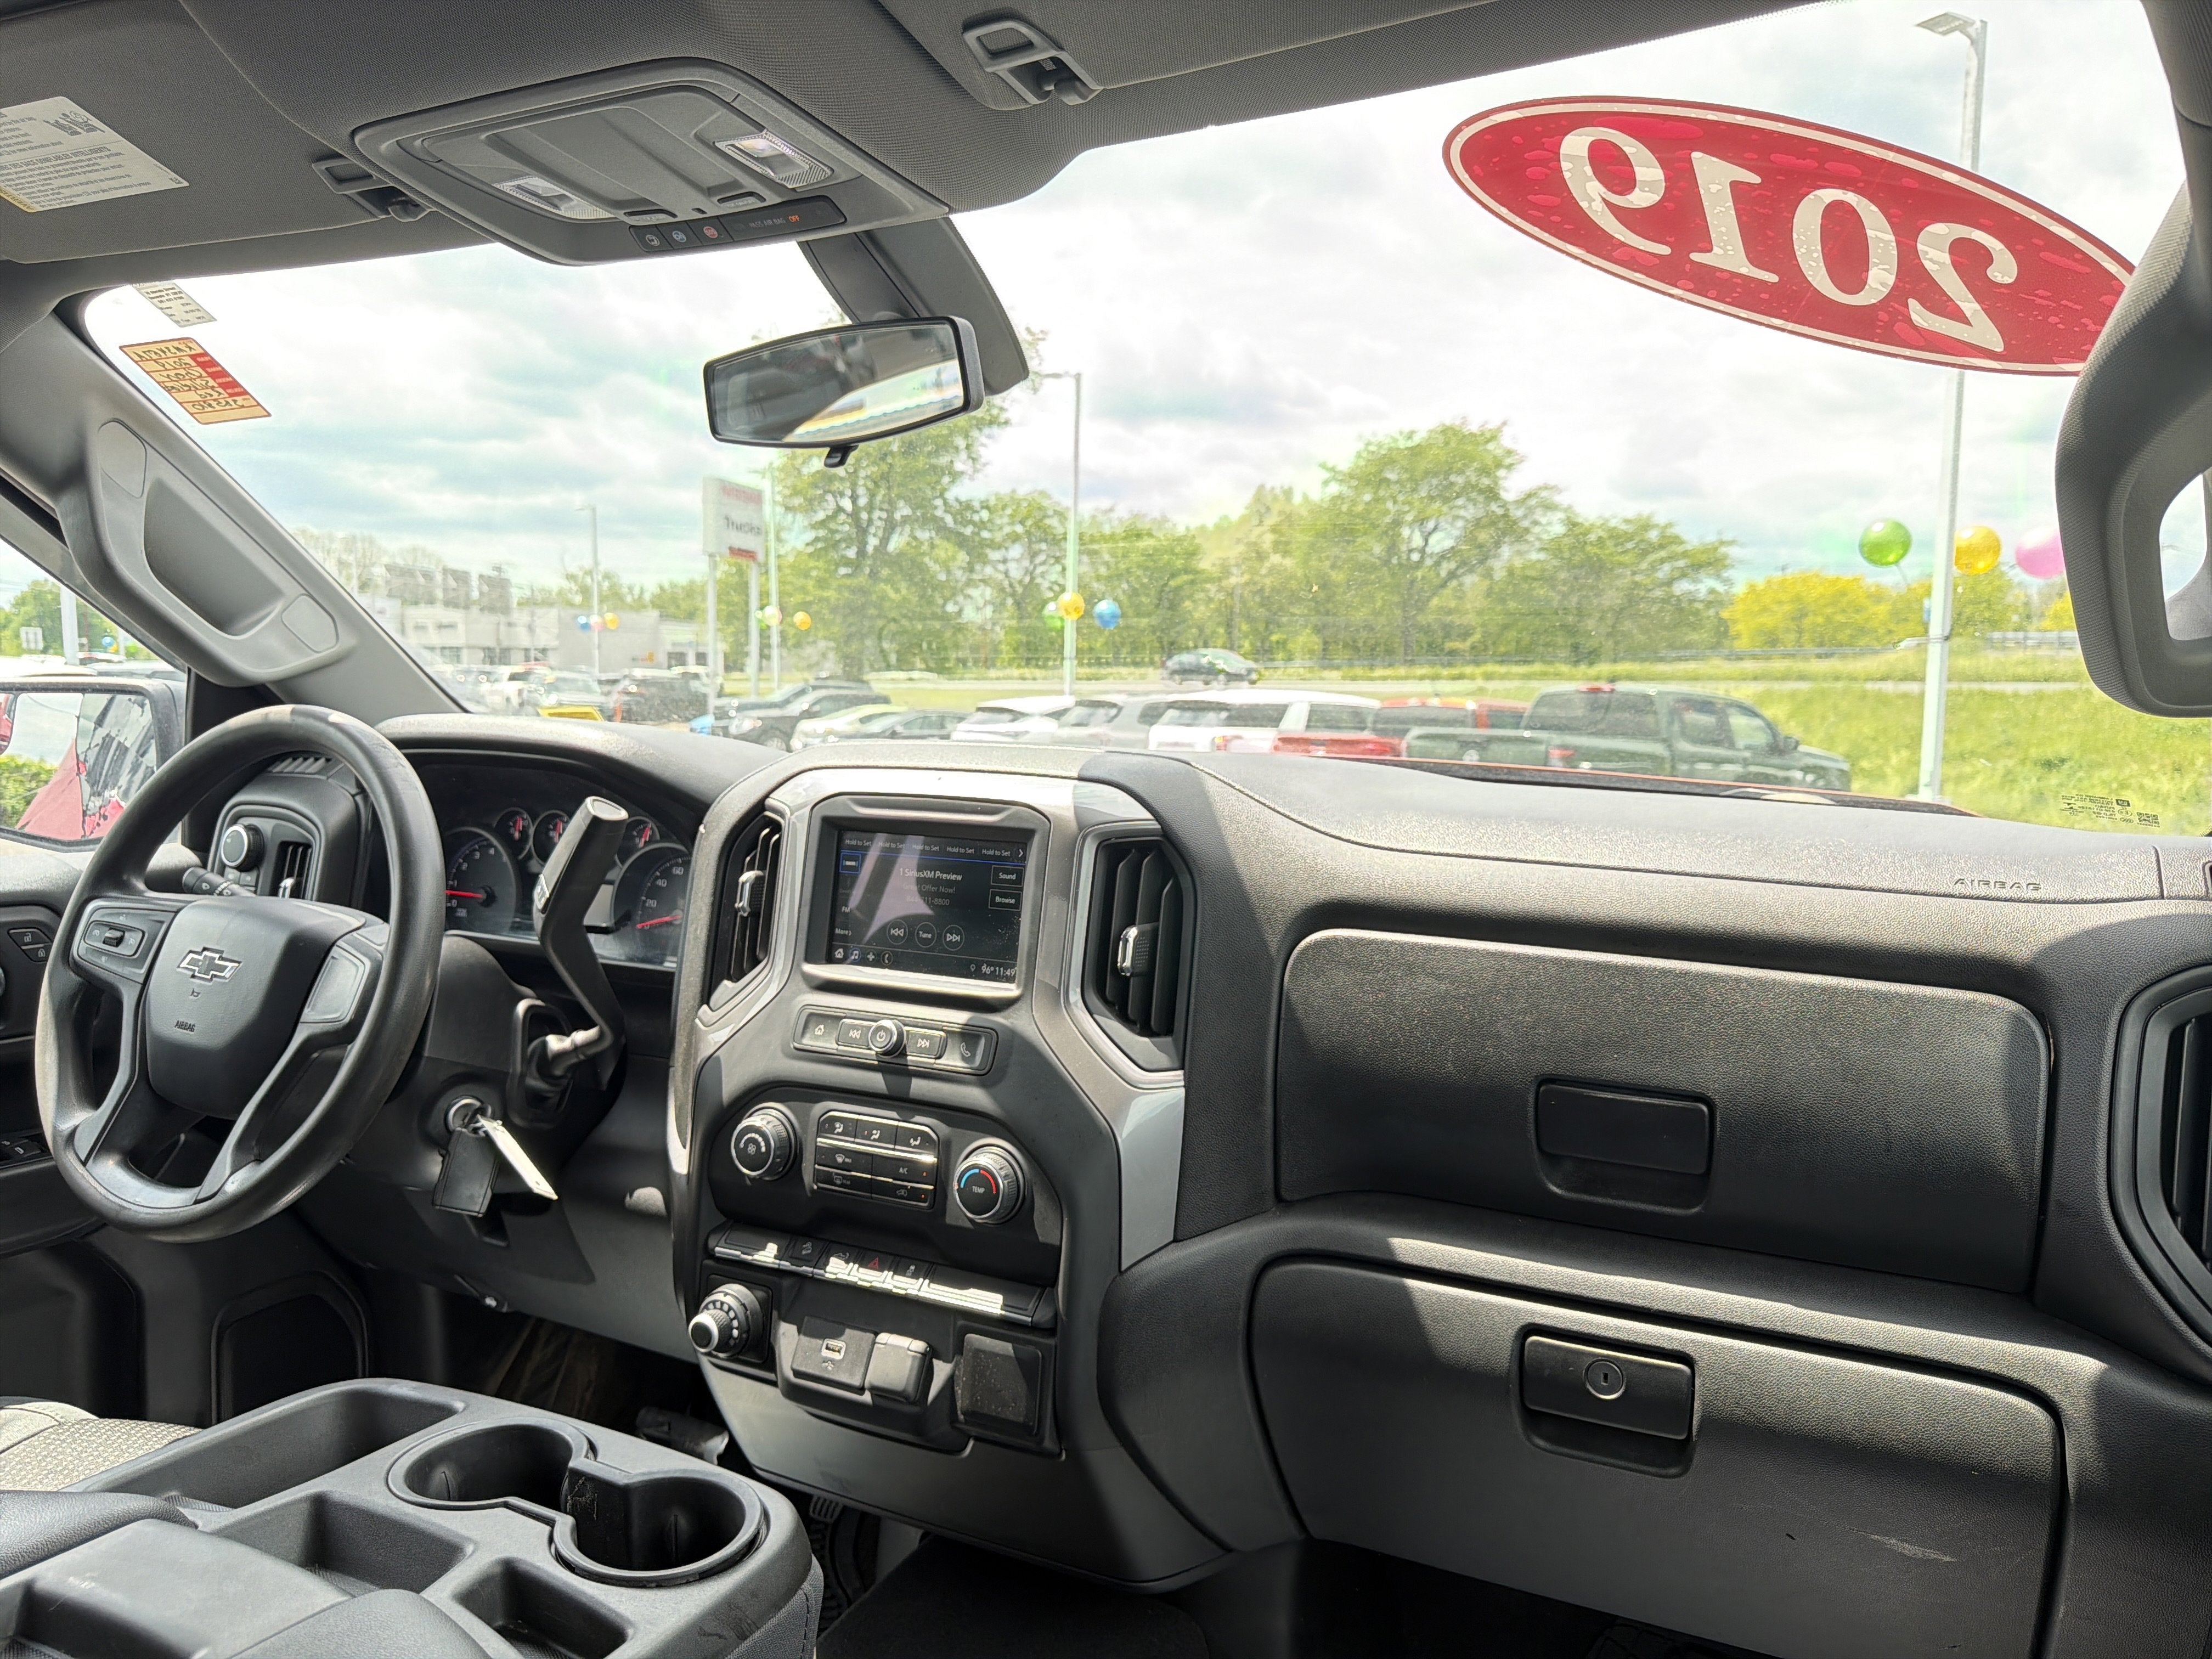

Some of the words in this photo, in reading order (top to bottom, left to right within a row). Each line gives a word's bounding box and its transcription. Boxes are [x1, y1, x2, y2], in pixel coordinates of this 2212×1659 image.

[672, 866, 684, 876] 60
[905, 868, 934, 878] SiriusXM
[935, 871, 962, 881] Preview
[656, 879, 667, 888] 40
[1954, 878, 2041, 891] AIRBAG
[939, 885, 956, 894] Now!
[646, 899, 657, 908] 20
[995, 896, 1015, 904] Browse
[995, 967, 1015, 977] 11:49
[174, 1020, 196, 1032] AIRBAG
[972, 1186, 985, 1194] TEMP
